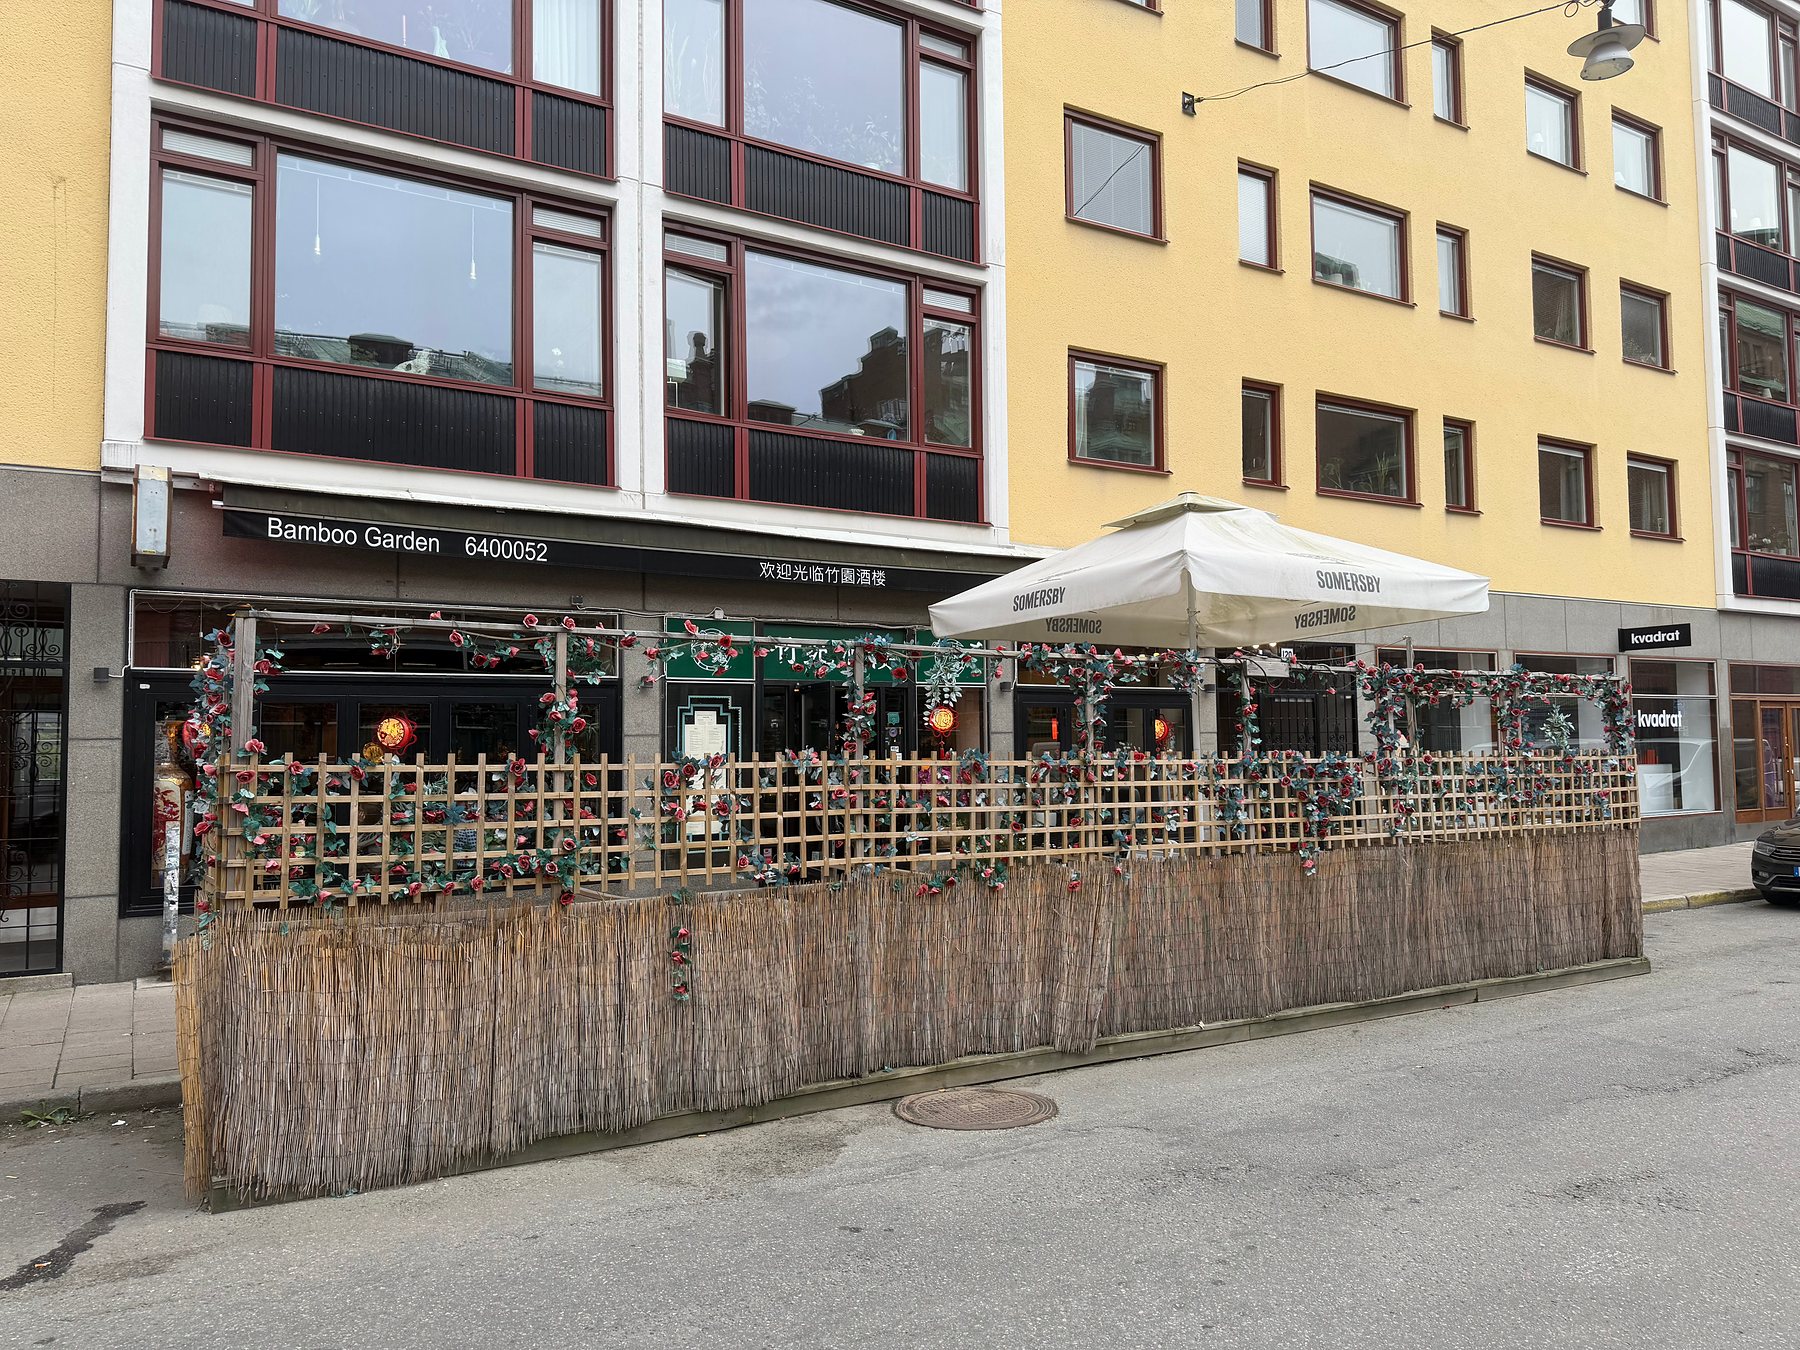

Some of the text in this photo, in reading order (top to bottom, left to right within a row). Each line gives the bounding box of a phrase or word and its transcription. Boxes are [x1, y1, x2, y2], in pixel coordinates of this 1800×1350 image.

[267, 516, 548, 562] Bamboo Garden 6400052
[759, 561, 887, 587] 欢迎光临竹園酒楼
[1316, 570, 1381, 593] SOMERSBY
[1012, 586, 1066, 612] SOMERSBY
[1631, 630, 1681, 645] kvadrat
[1637, 709, 1683, 728] kvadrat
